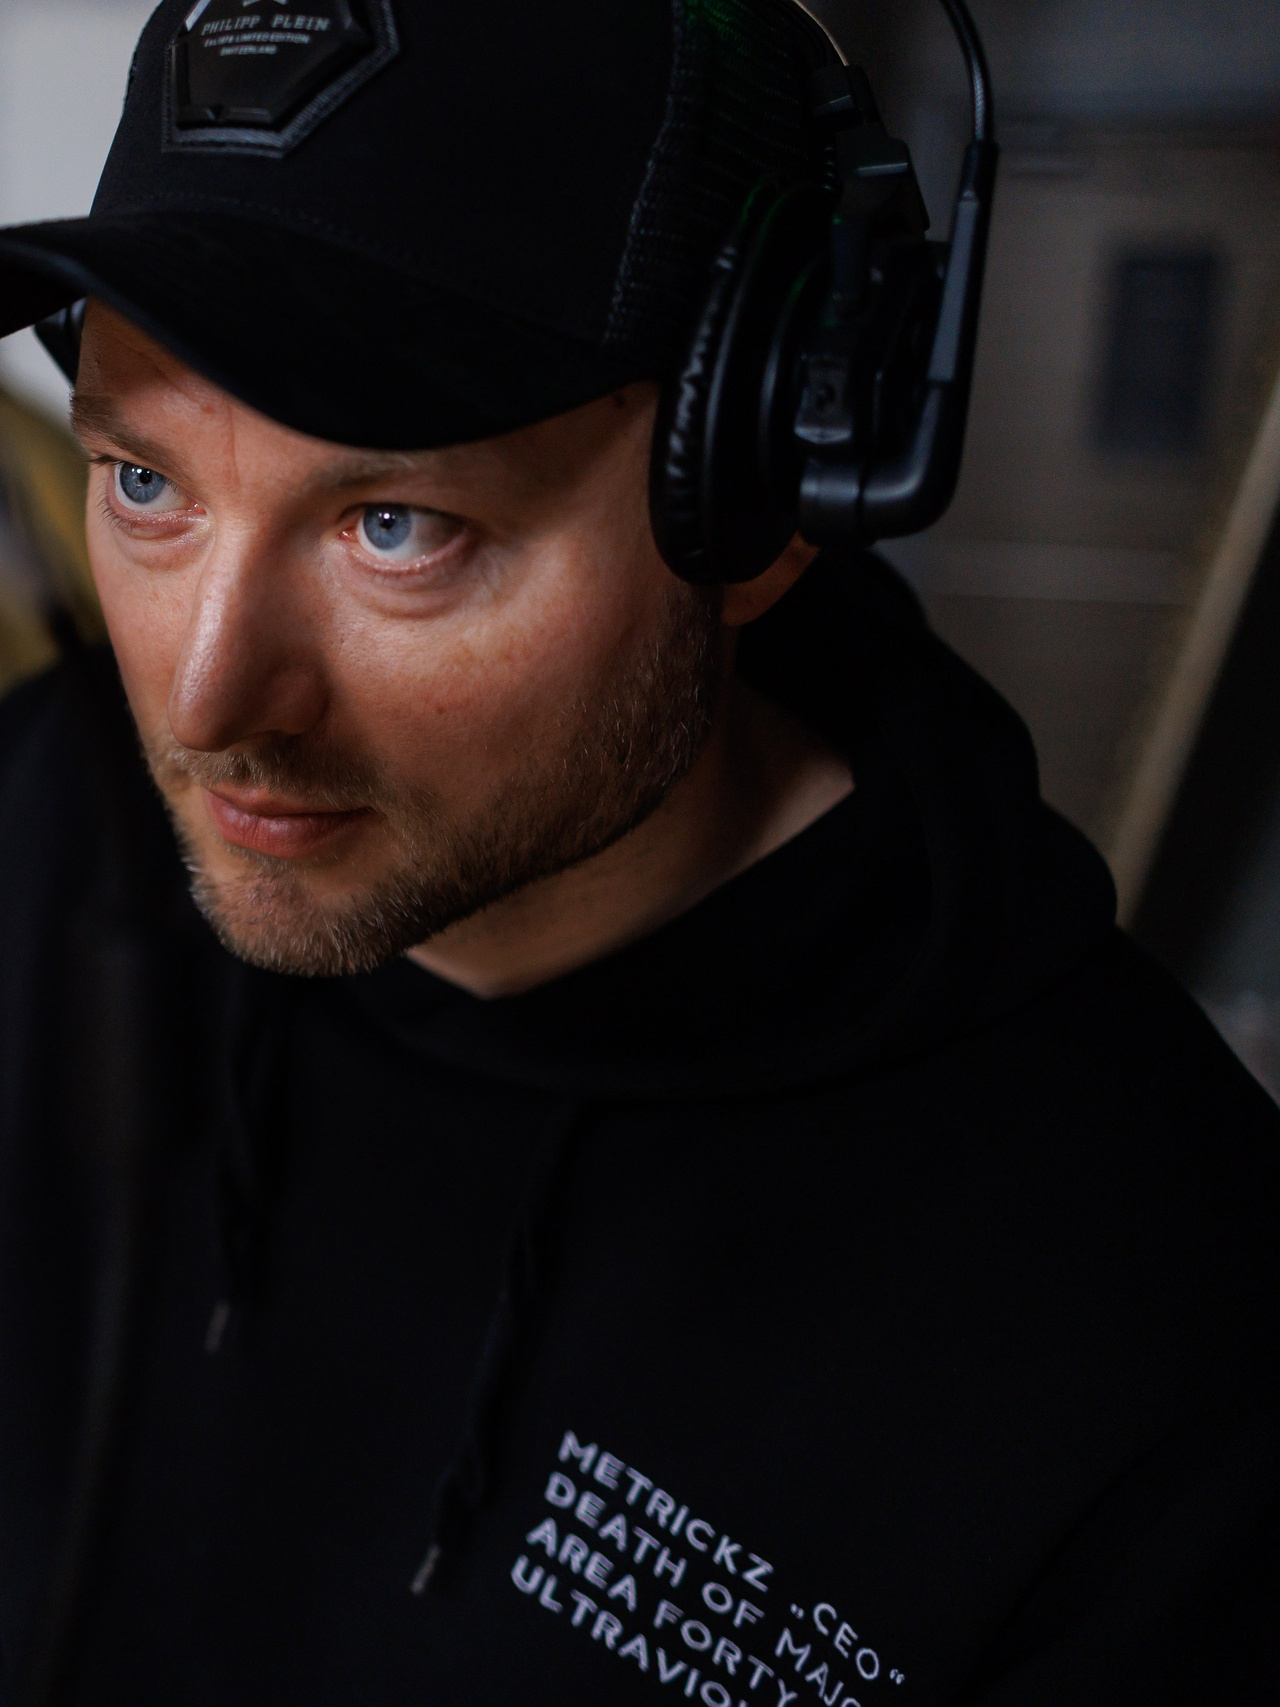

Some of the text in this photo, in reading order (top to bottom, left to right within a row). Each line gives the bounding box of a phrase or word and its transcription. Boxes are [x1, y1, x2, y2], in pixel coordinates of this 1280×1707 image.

[201, 14, 330, 36] PHILIPP PLEIN
[544, 1471, 687, 1587] DEATH
[701, 1582, 764, 1628] OF
[558, 1431, 773, 1592] METRICKZ
[510, 1555, 747, 1707] ULTRAVIO
[526, 1517, 797, 1707] AREA FORTY
